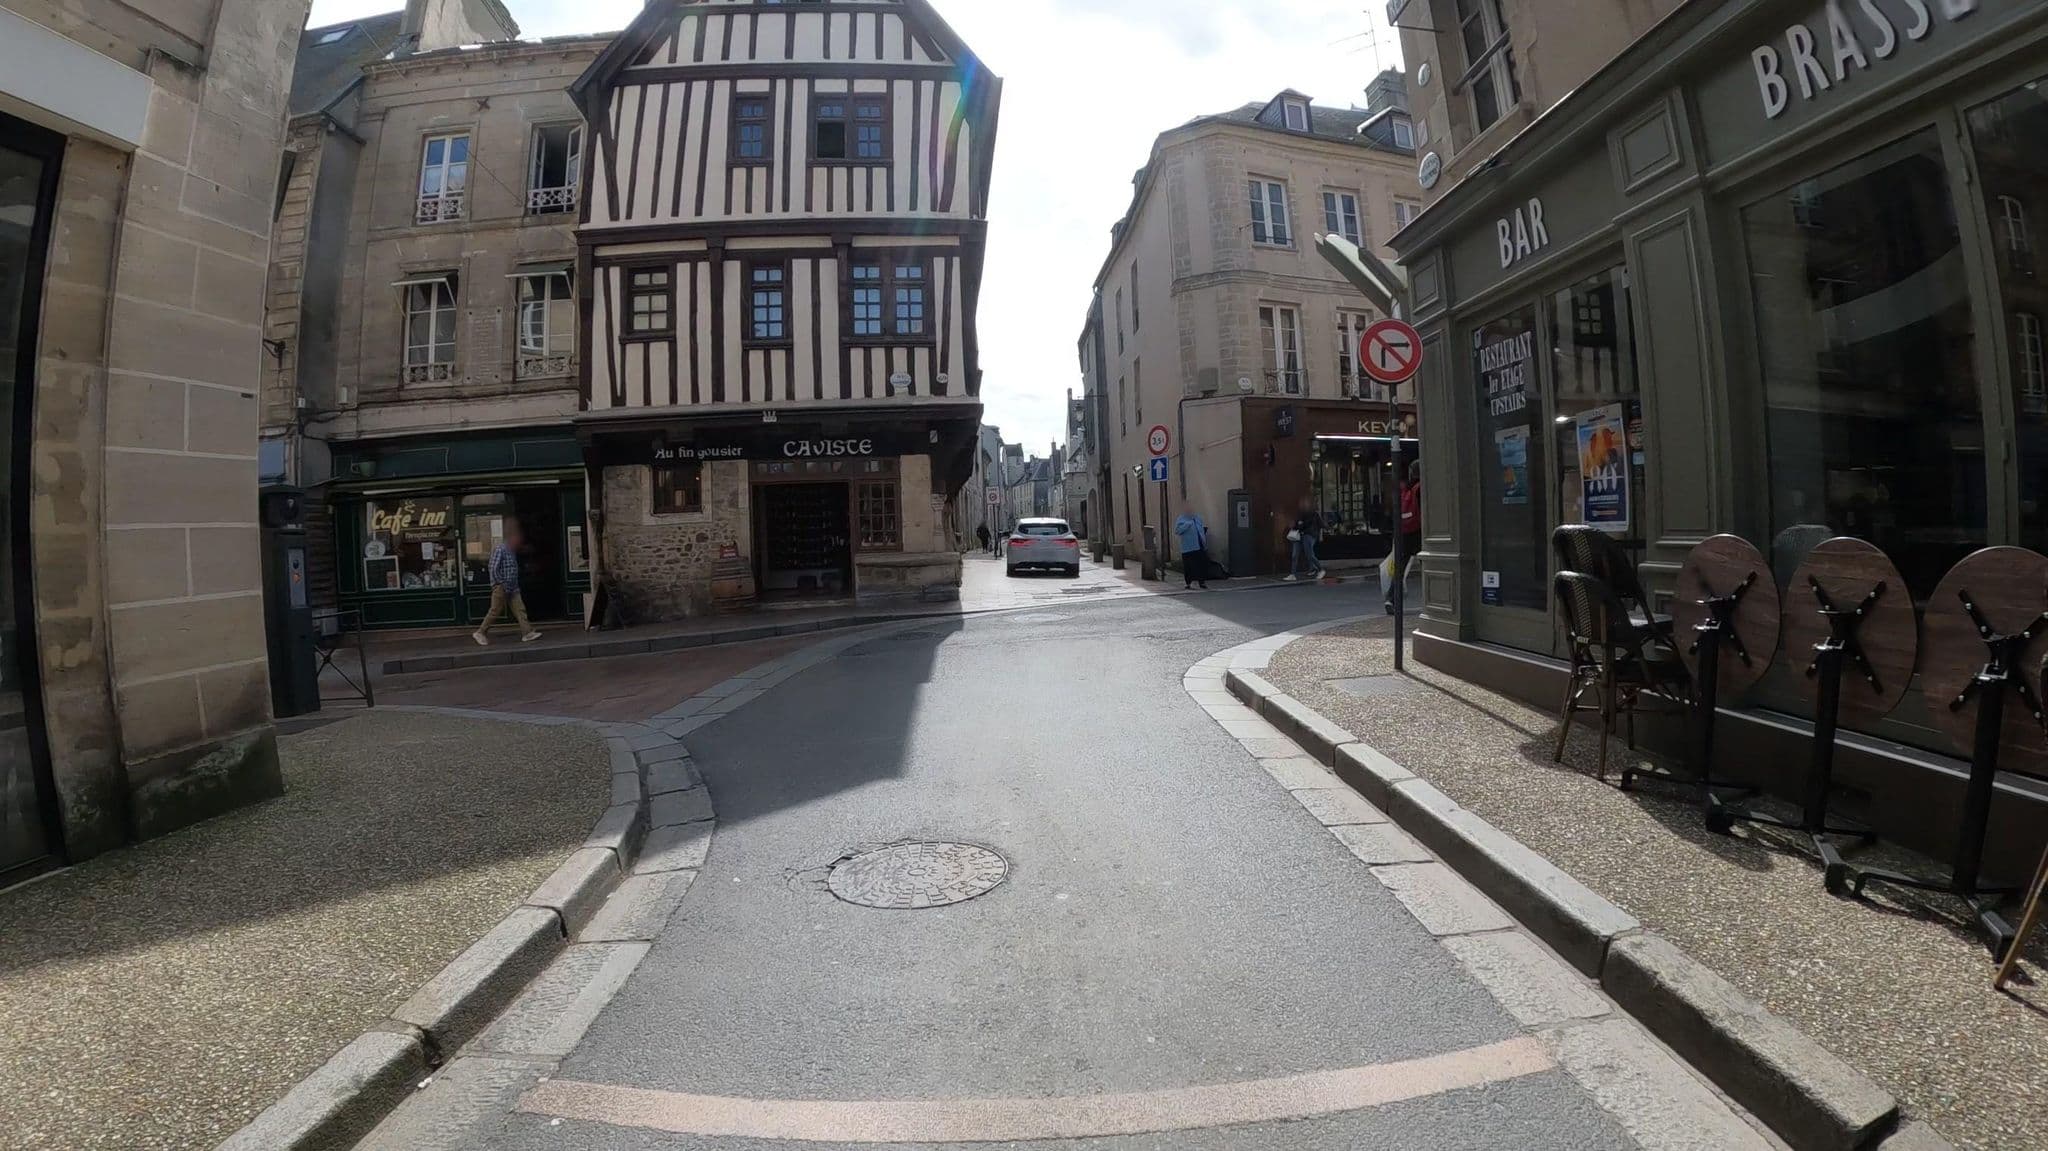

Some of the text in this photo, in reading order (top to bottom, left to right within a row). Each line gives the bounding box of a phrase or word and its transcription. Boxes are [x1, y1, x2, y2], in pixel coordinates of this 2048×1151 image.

[1497, 197, 1548, 269] BAR
[1480, 331, 1531, 373] RESTAURANT
[1501, 363, 1524, 390] ETAGE
[1490, 390, 1526, 416] UPSTAIRS
[655, 445, 743, 460] Au fin gousier
[783, 438, 873, 457] CAVISTE
